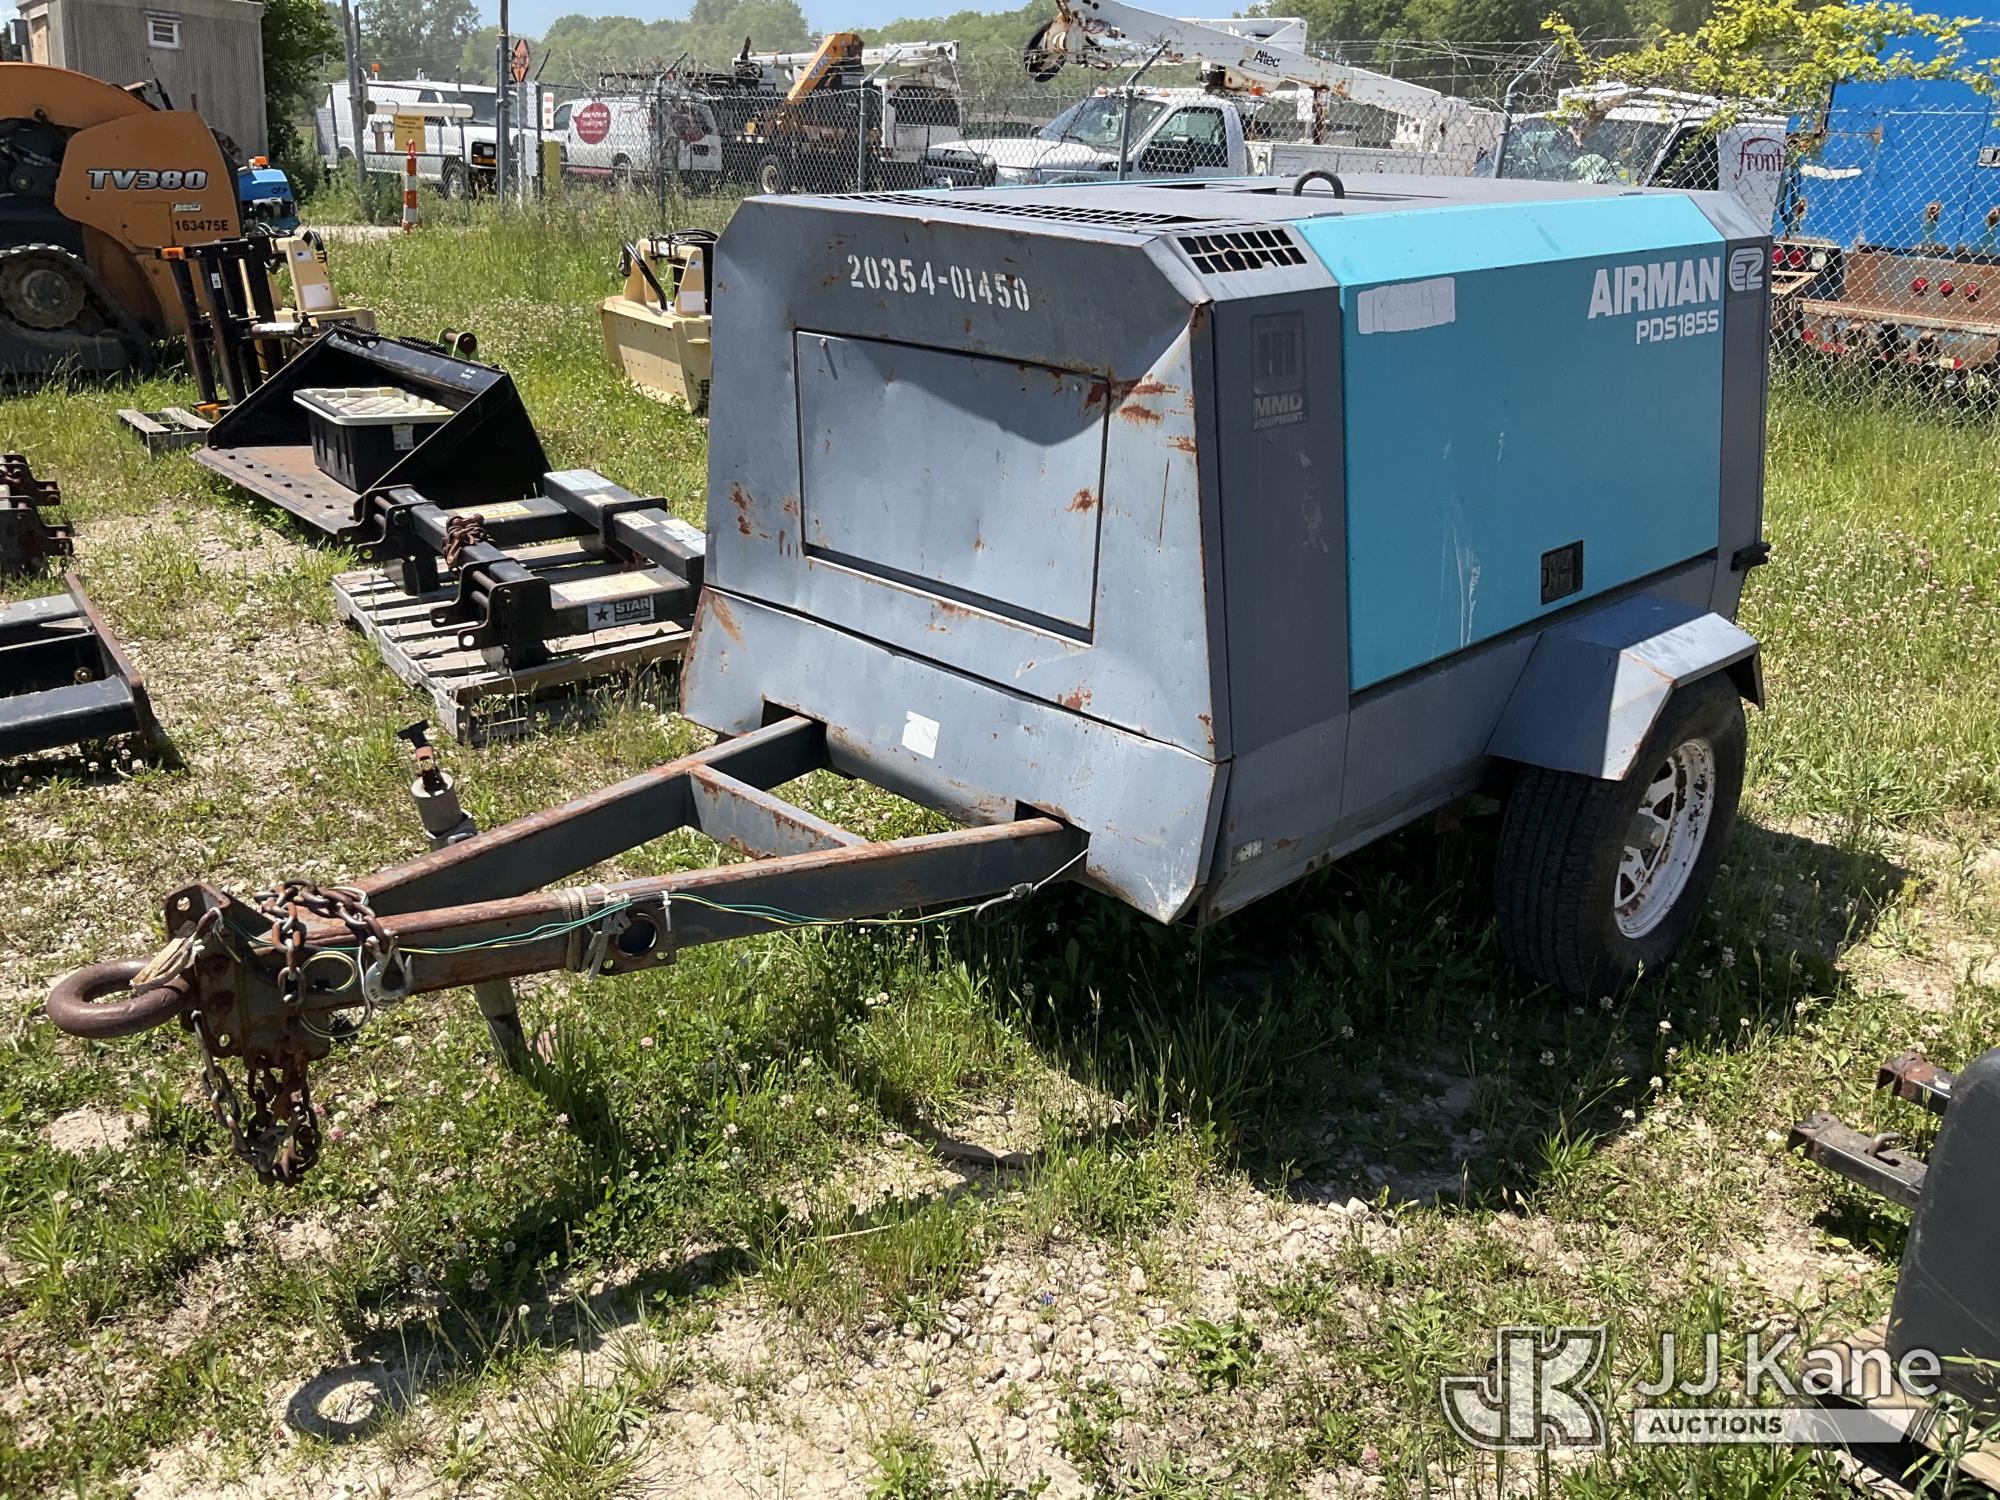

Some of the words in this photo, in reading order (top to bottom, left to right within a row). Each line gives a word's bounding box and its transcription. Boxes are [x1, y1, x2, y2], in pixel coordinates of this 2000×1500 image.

[1253, 49, 1280, 68] Altec
[86, 168, 208, 191] TV380
[174, 219, 229, 232] 163475E
[847, 254, 1030, 312] 20354-01450
[1587, 256, 1721, 320] AIRMAN
[1636, 309, 1719, 344] PDS185S
[1252, 392, 1304, 417] MMD
[615, 597, 649, 613] STAR
